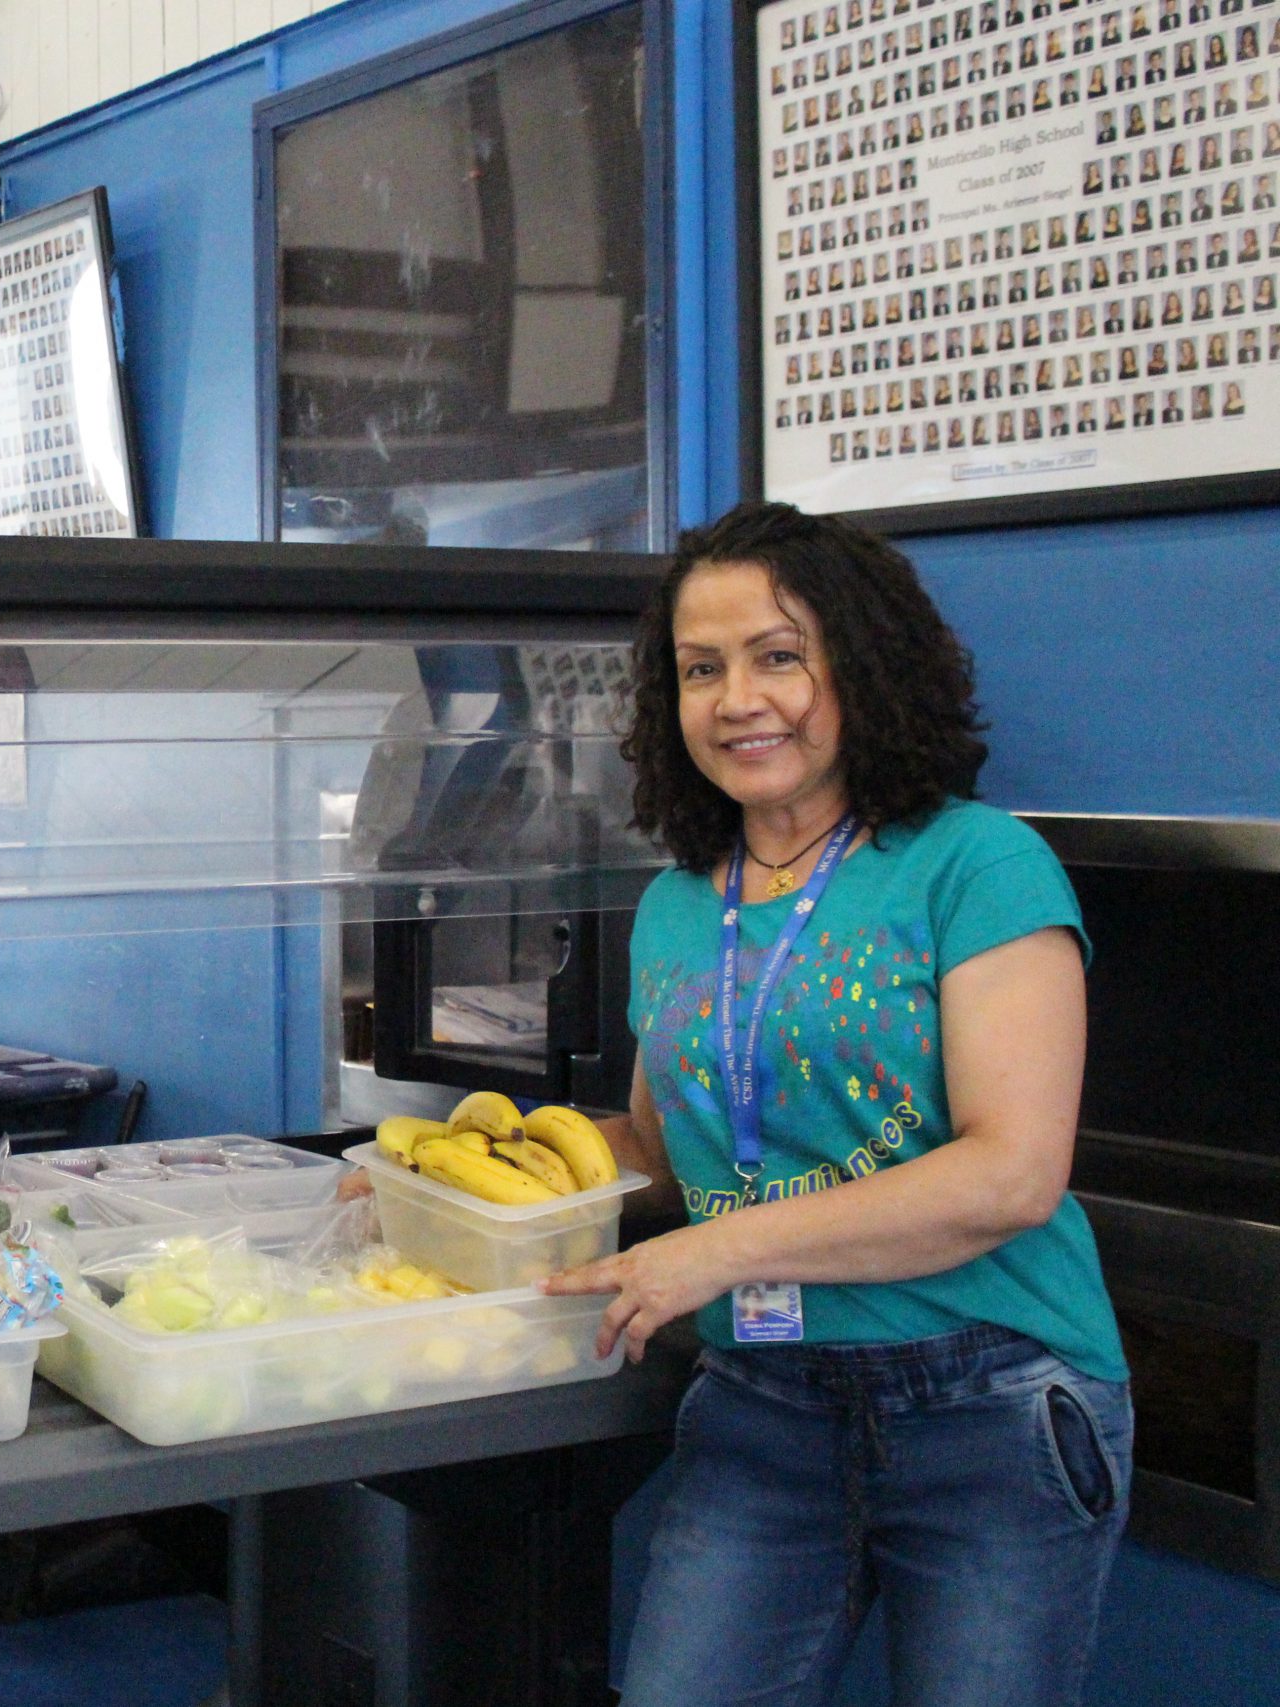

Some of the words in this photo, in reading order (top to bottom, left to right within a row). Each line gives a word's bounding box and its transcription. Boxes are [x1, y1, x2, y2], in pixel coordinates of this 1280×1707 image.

[928, 141, 995, 171] Monticello
[999, 132, 1032, 154] High
[1036, 121, 1085, 145] School
[958, 176, 995, 193] Class
[999, 167, 1012, 185] of
[1016, 161, 1046, 181] 2007
